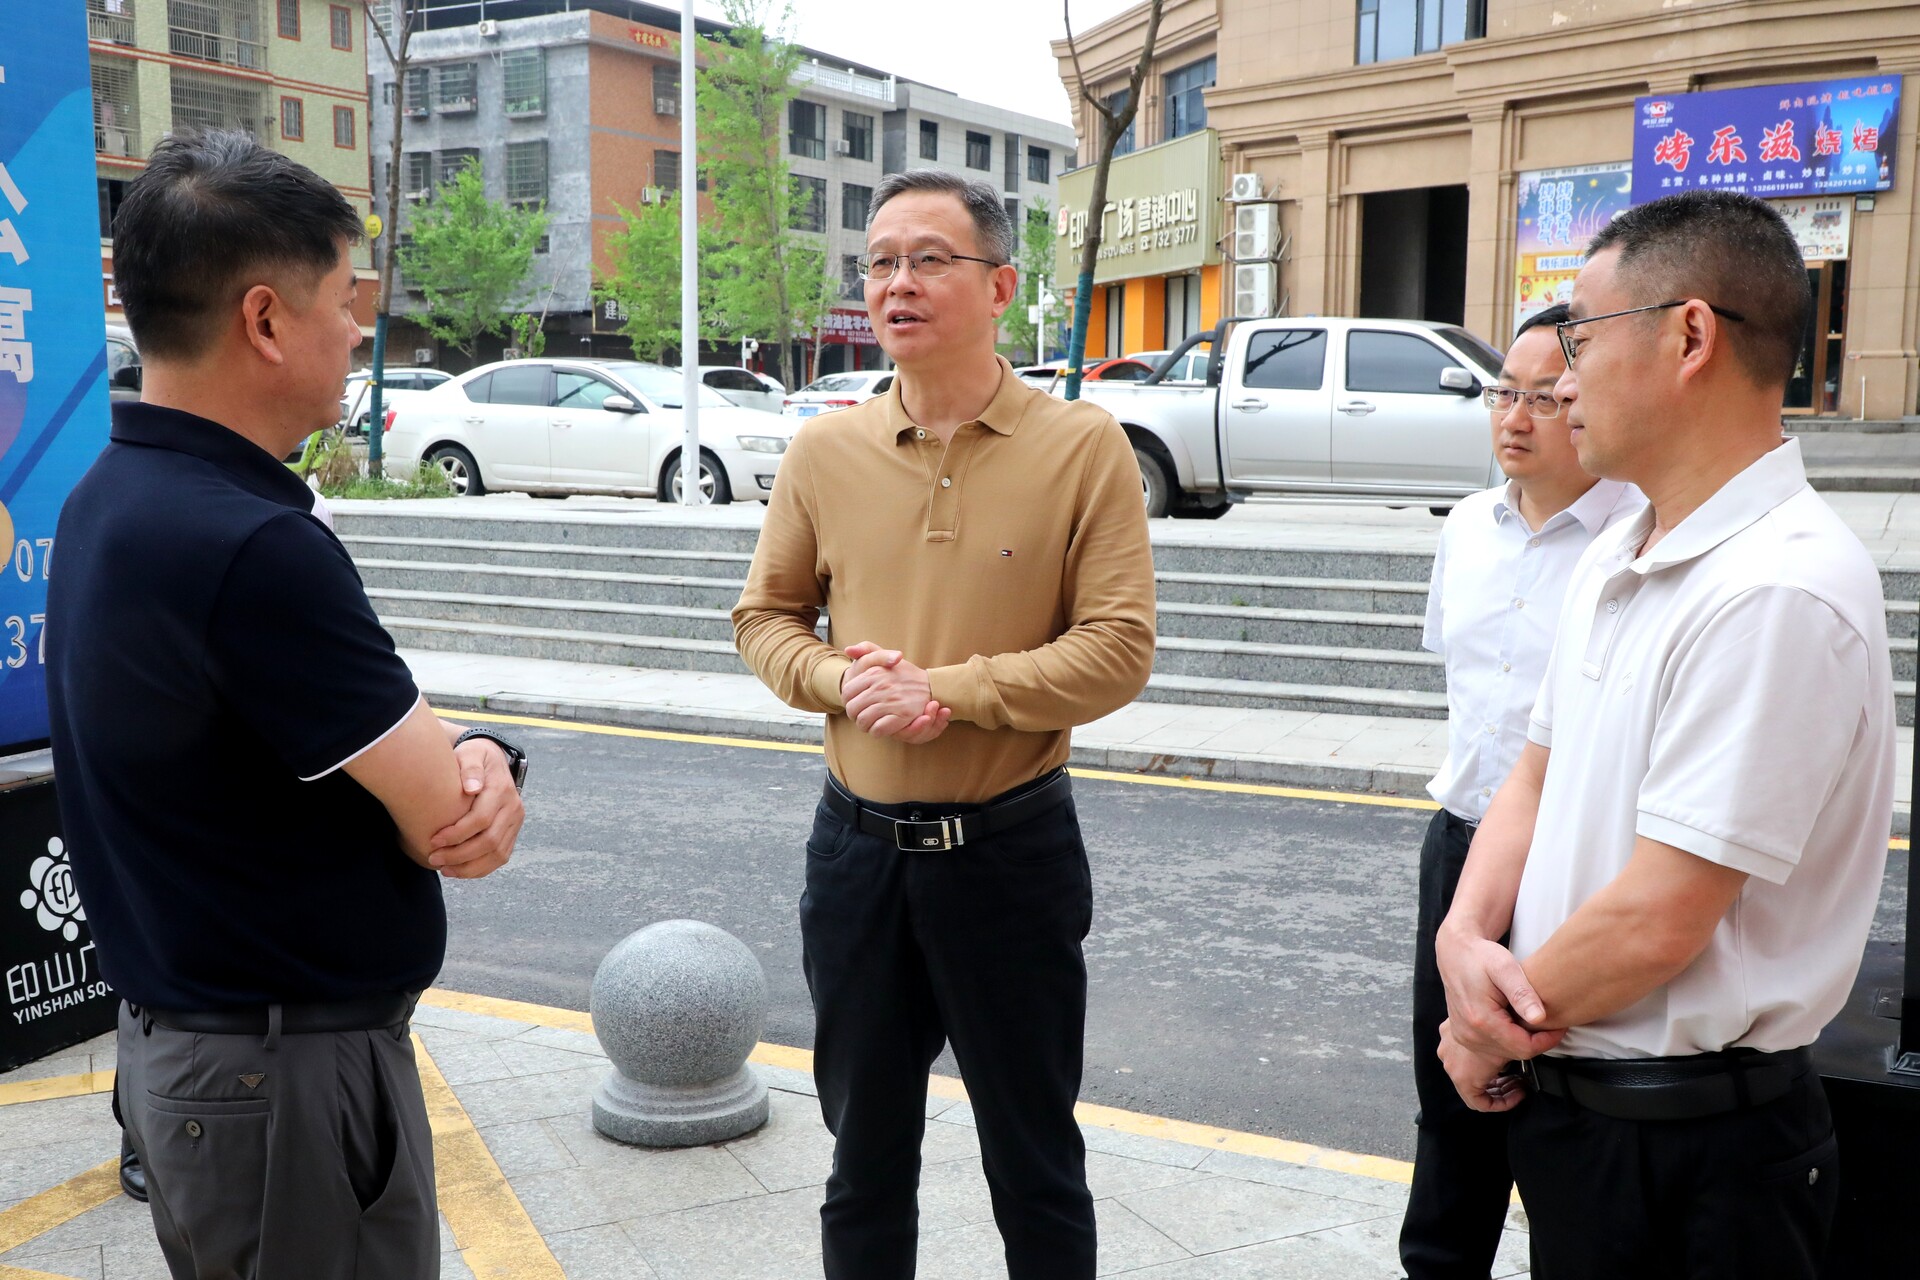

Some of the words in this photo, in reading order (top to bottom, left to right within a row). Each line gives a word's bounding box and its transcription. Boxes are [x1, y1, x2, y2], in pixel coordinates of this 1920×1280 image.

[1138, 188, 1198, 233] 营销中心
[13, 988, 85, 1025] YINSHAN
